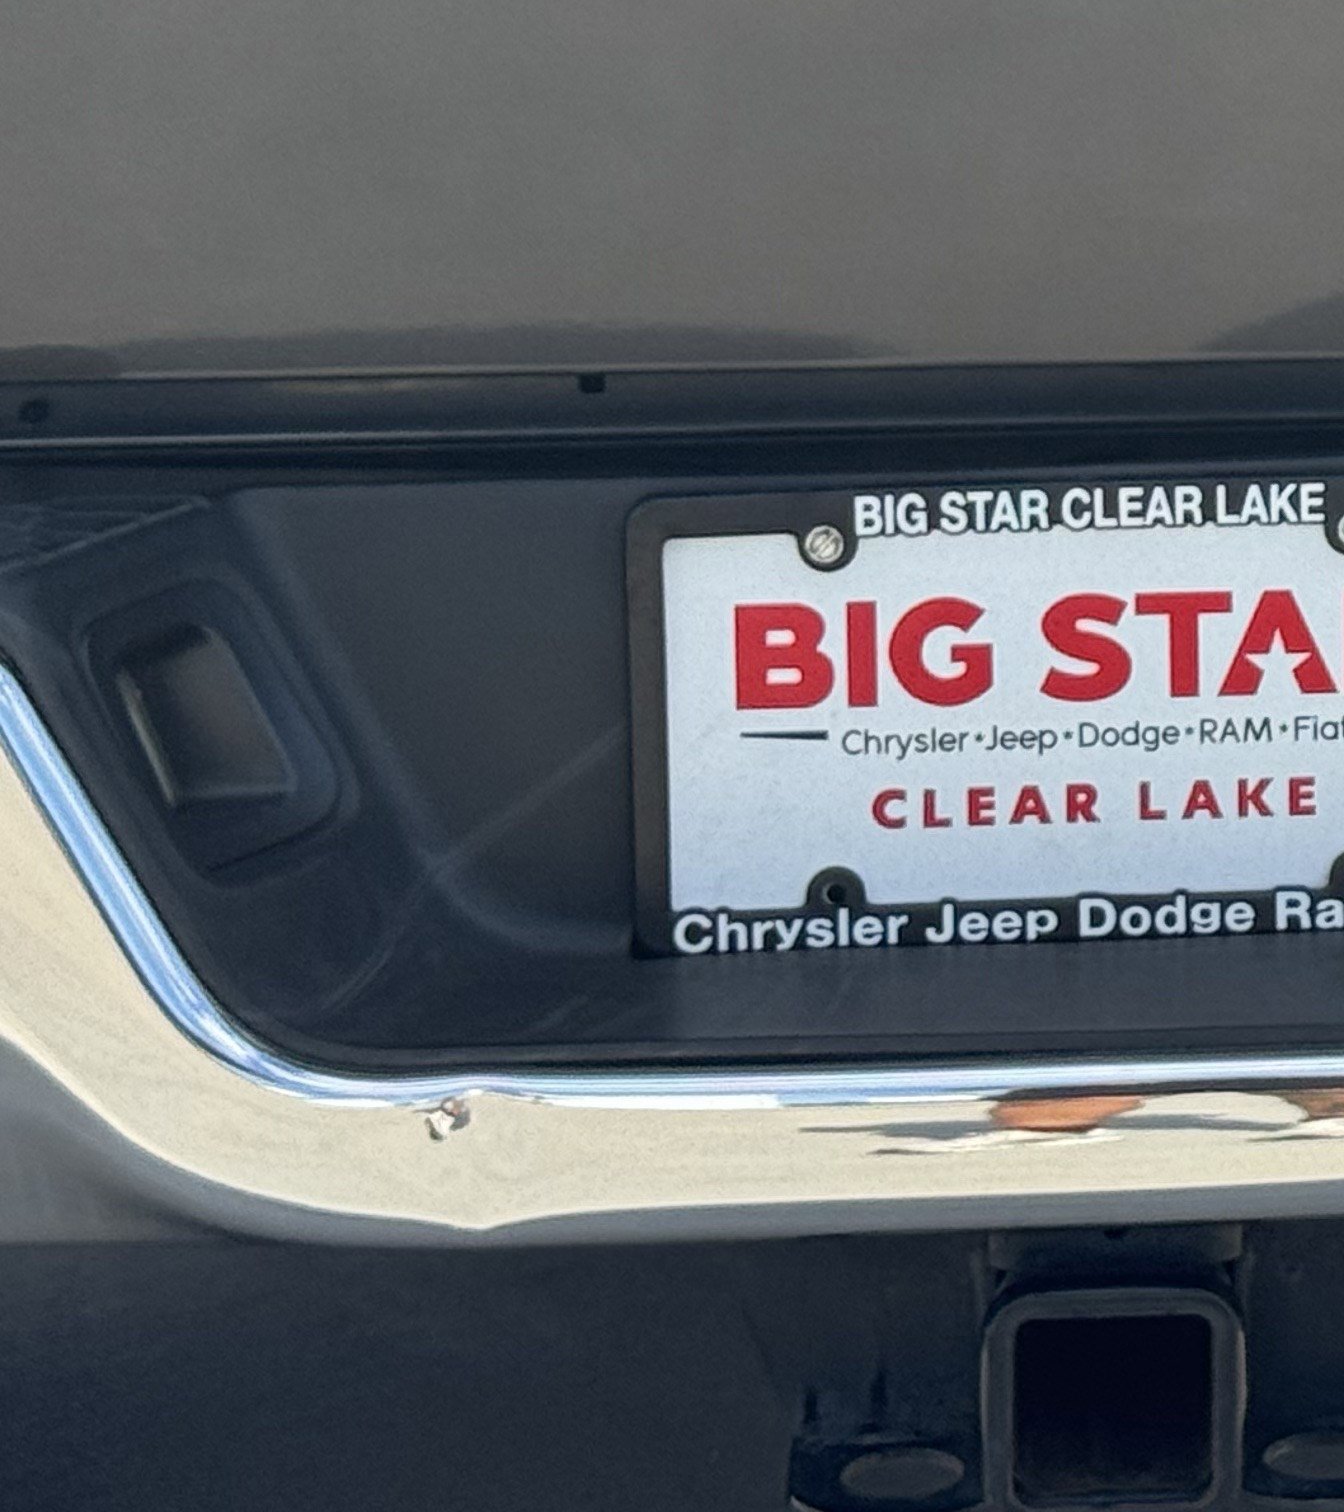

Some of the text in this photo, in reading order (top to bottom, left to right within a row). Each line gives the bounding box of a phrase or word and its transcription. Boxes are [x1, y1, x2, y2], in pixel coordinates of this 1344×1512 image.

[853, 482, 1327, 537] BIG STAR CLEAR LAKE
[732, 595, 994, 710] BIG
[871, 775, 1318, 830] CLEAR LAKE
[672, 906, 908, 956] Chrysler
[925, 900, 1060, 944] Jeep
[1077, 889, 1256, 940] Dodge
